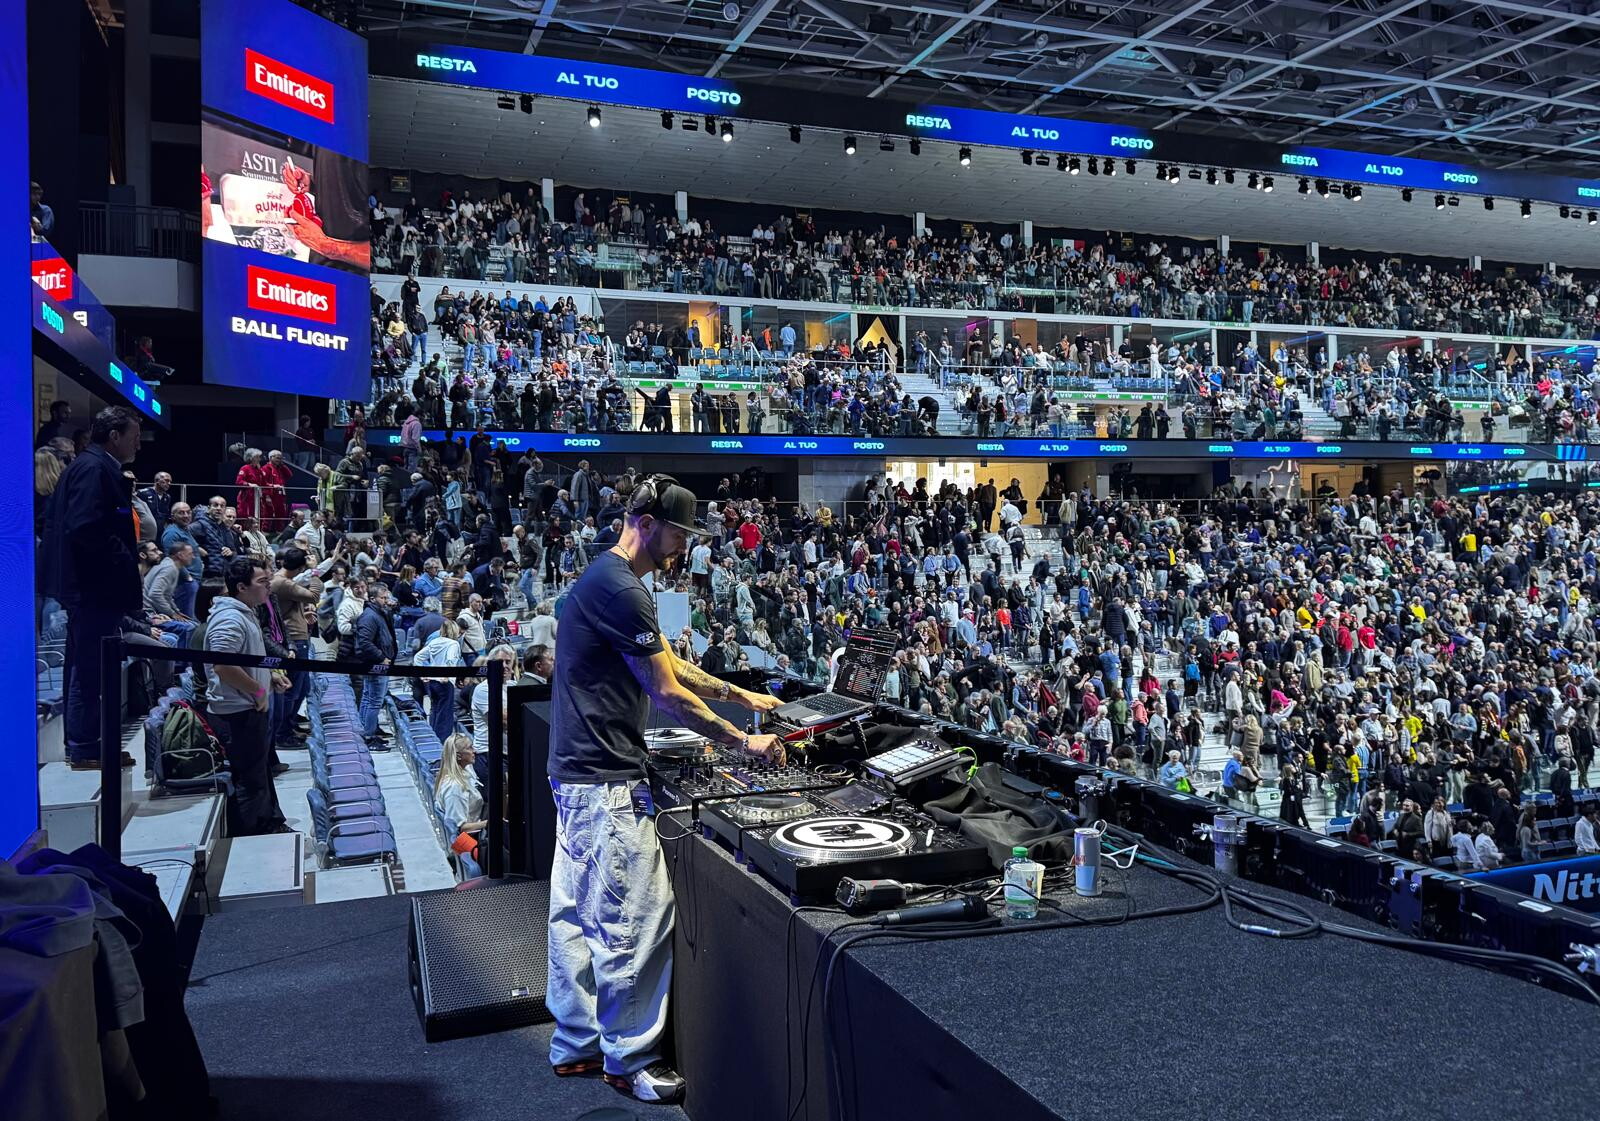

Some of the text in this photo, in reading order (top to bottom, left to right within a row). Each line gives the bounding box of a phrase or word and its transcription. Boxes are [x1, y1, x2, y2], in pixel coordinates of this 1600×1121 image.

[254, 62, 326, 109] Emirates
[416, 54, 742, 105] RESTA AL TUO POSTO
[905, 114, 1154, 150] RESTA AL TUO POSTO
[241, 151, 277, 174] ASTI
[1281, 153, 1479, 185] RESTA AL TUO POSTO
[256, 277, 329, 312] Emirates
[231, 316, 349, 351] BALL FLIGHT
[563, 438, 601, 447] POSTO
[711, 440, 885, 450] RESTA AL TUO POSTO
[976, 443, 1005, 451] RESTA
[1052, 444, 1070, 452] TUO
[1099, 444, 1128, 452] POSTO
